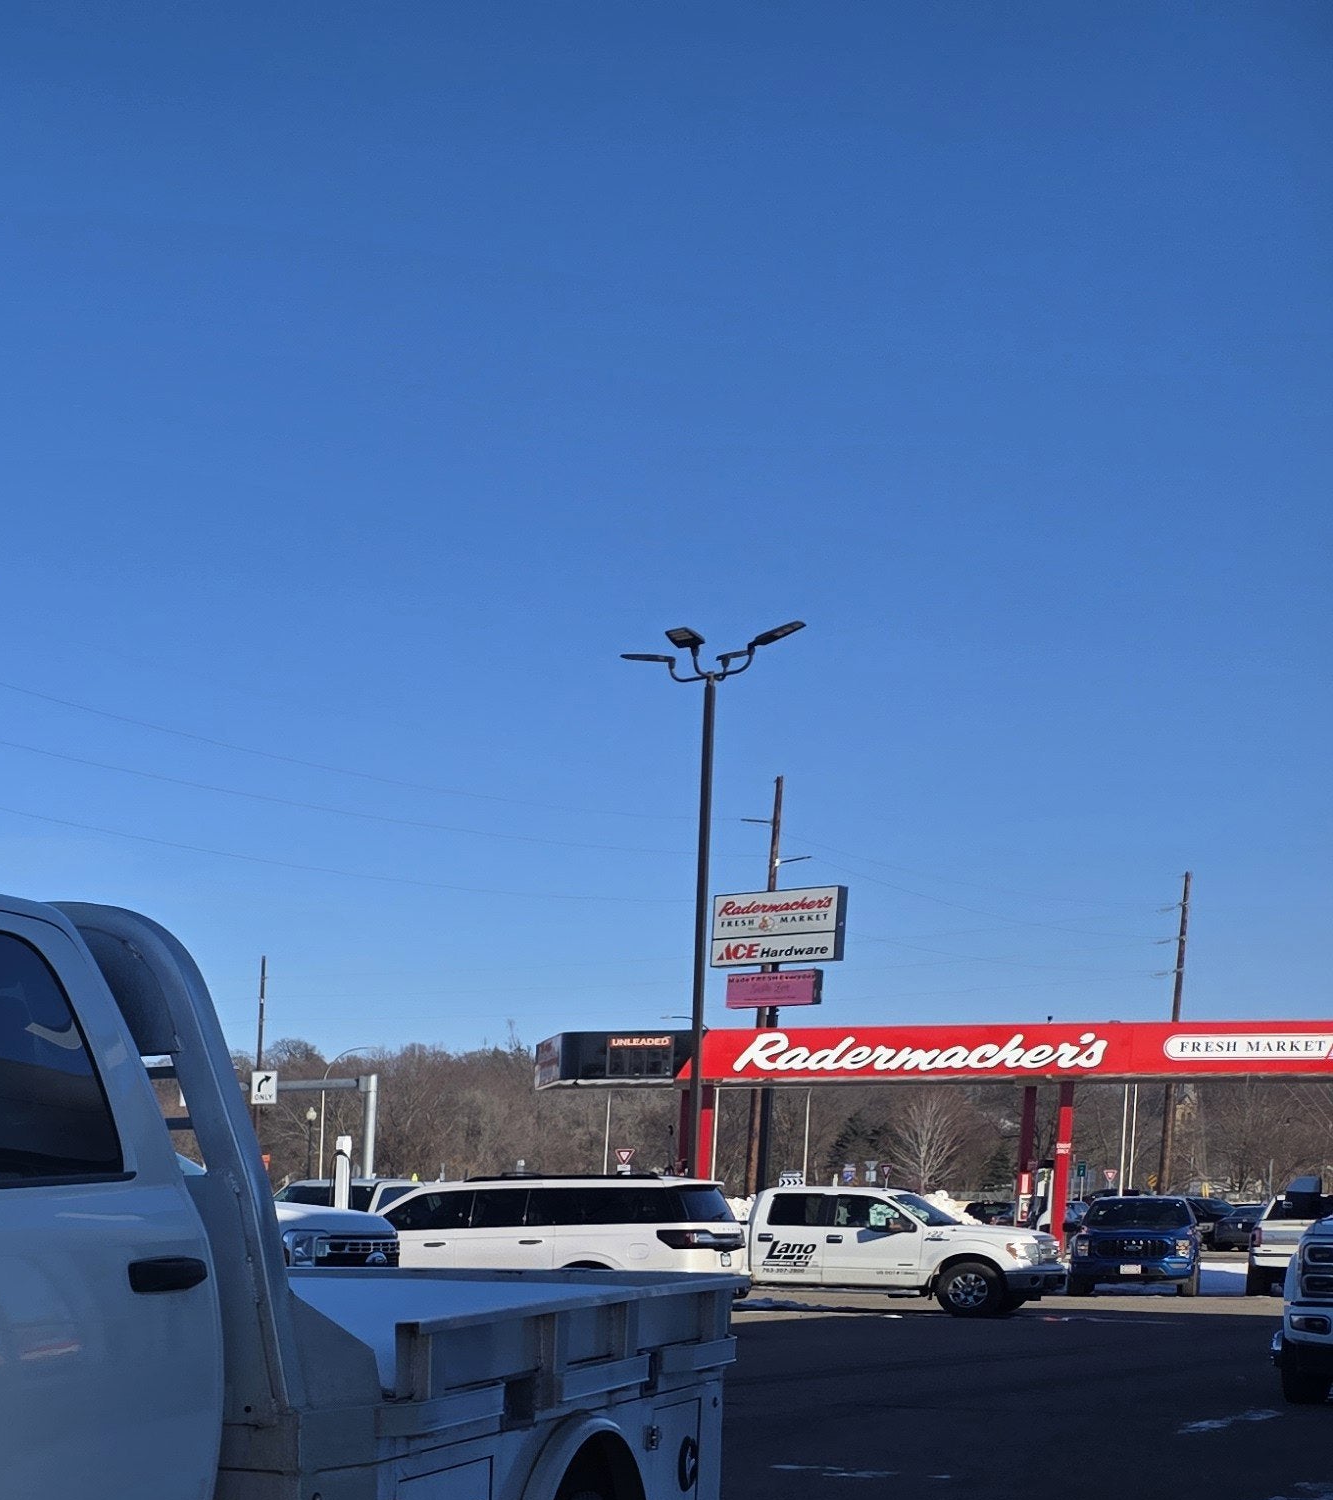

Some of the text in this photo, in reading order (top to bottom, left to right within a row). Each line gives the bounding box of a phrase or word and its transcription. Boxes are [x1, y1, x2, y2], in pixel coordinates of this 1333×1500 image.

[718, 896, 833, 918] Radermacher's
[721, 913, 828, 928] FRESH MARKET
[717, 942, 829, 961] ACE Hardware
[611, 1036, 670, 1047] UNLEADED
[1180, 1040, 1326, 1053] FRESH MARKET
[733, 1031, 1108, 1072] Radermacher's
[254, 1093, 273, 1101] ONLY
[765, 1240, 817, 1259] Lano
